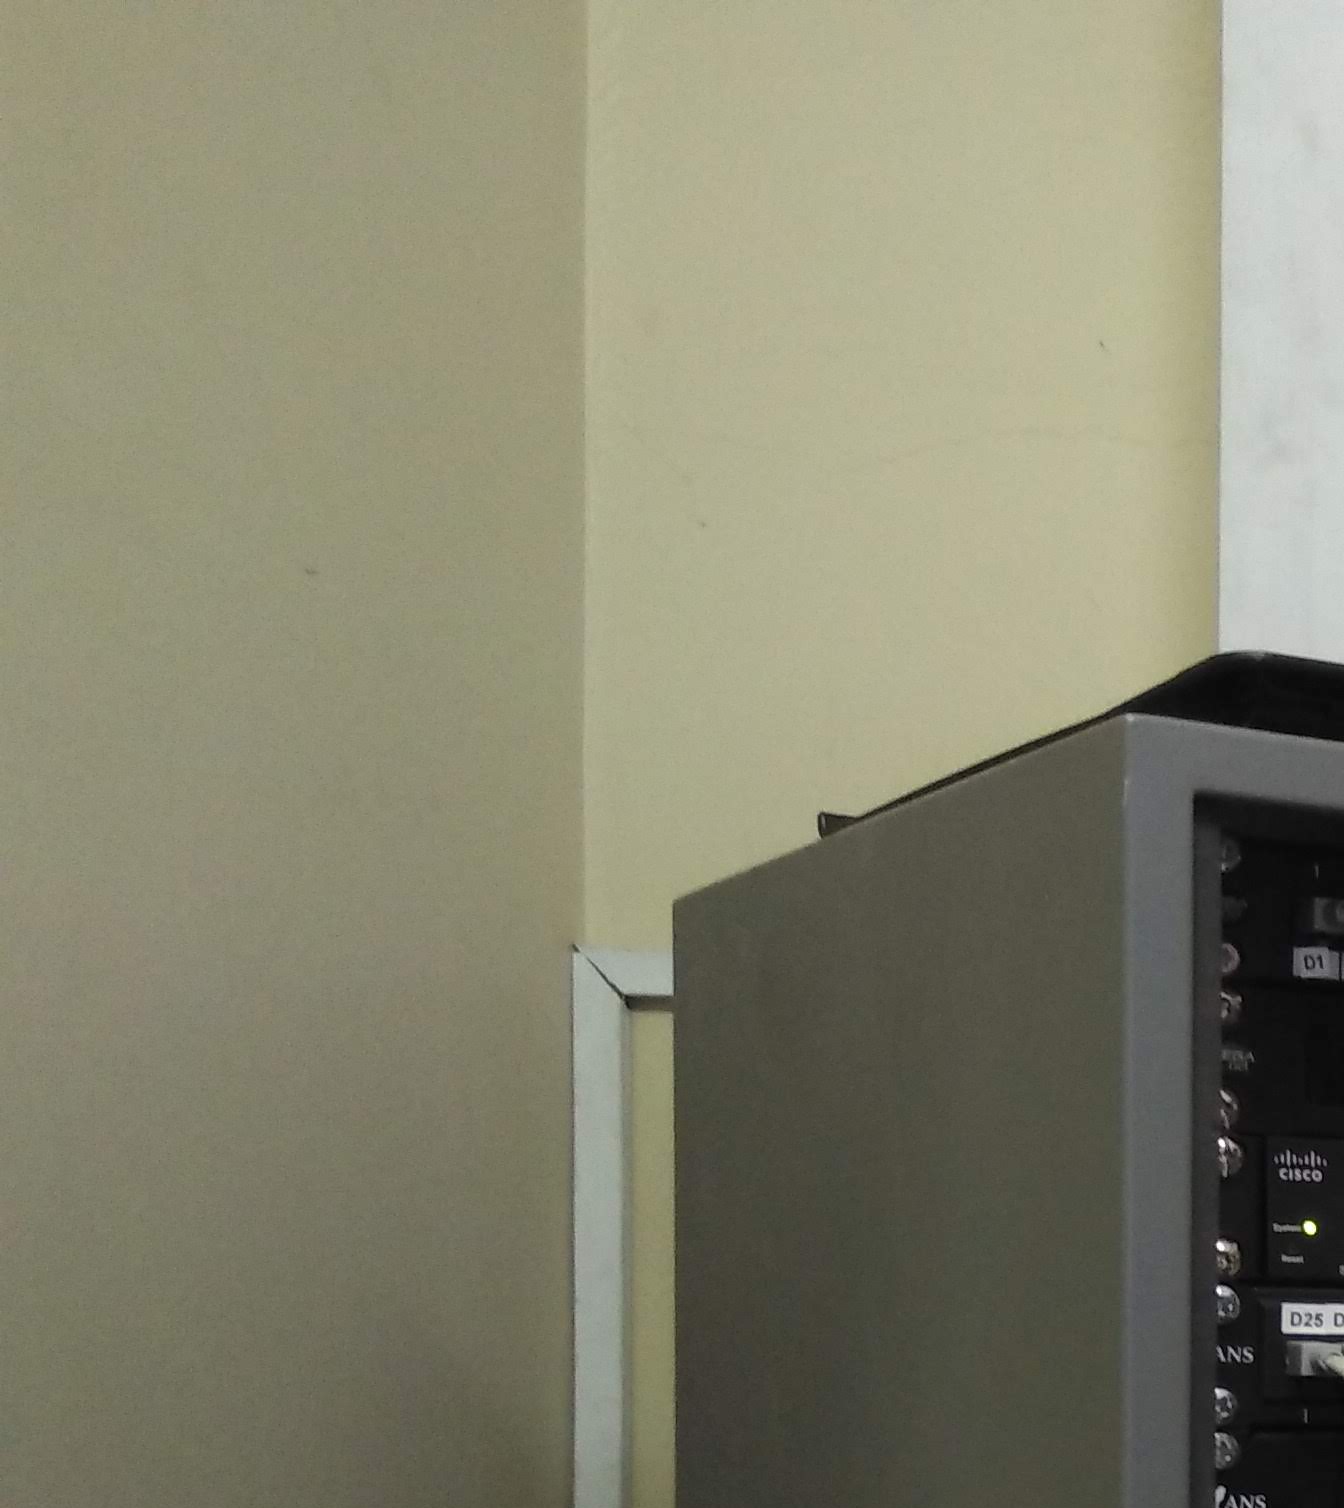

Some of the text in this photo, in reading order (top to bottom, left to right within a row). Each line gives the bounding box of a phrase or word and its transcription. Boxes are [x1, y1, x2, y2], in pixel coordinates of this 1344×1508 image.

[1303, 954, 1324, 971] D1
[1278, 1167, 1324, 1183] cisco
[1290, 1310, 1324, 1328] D25
